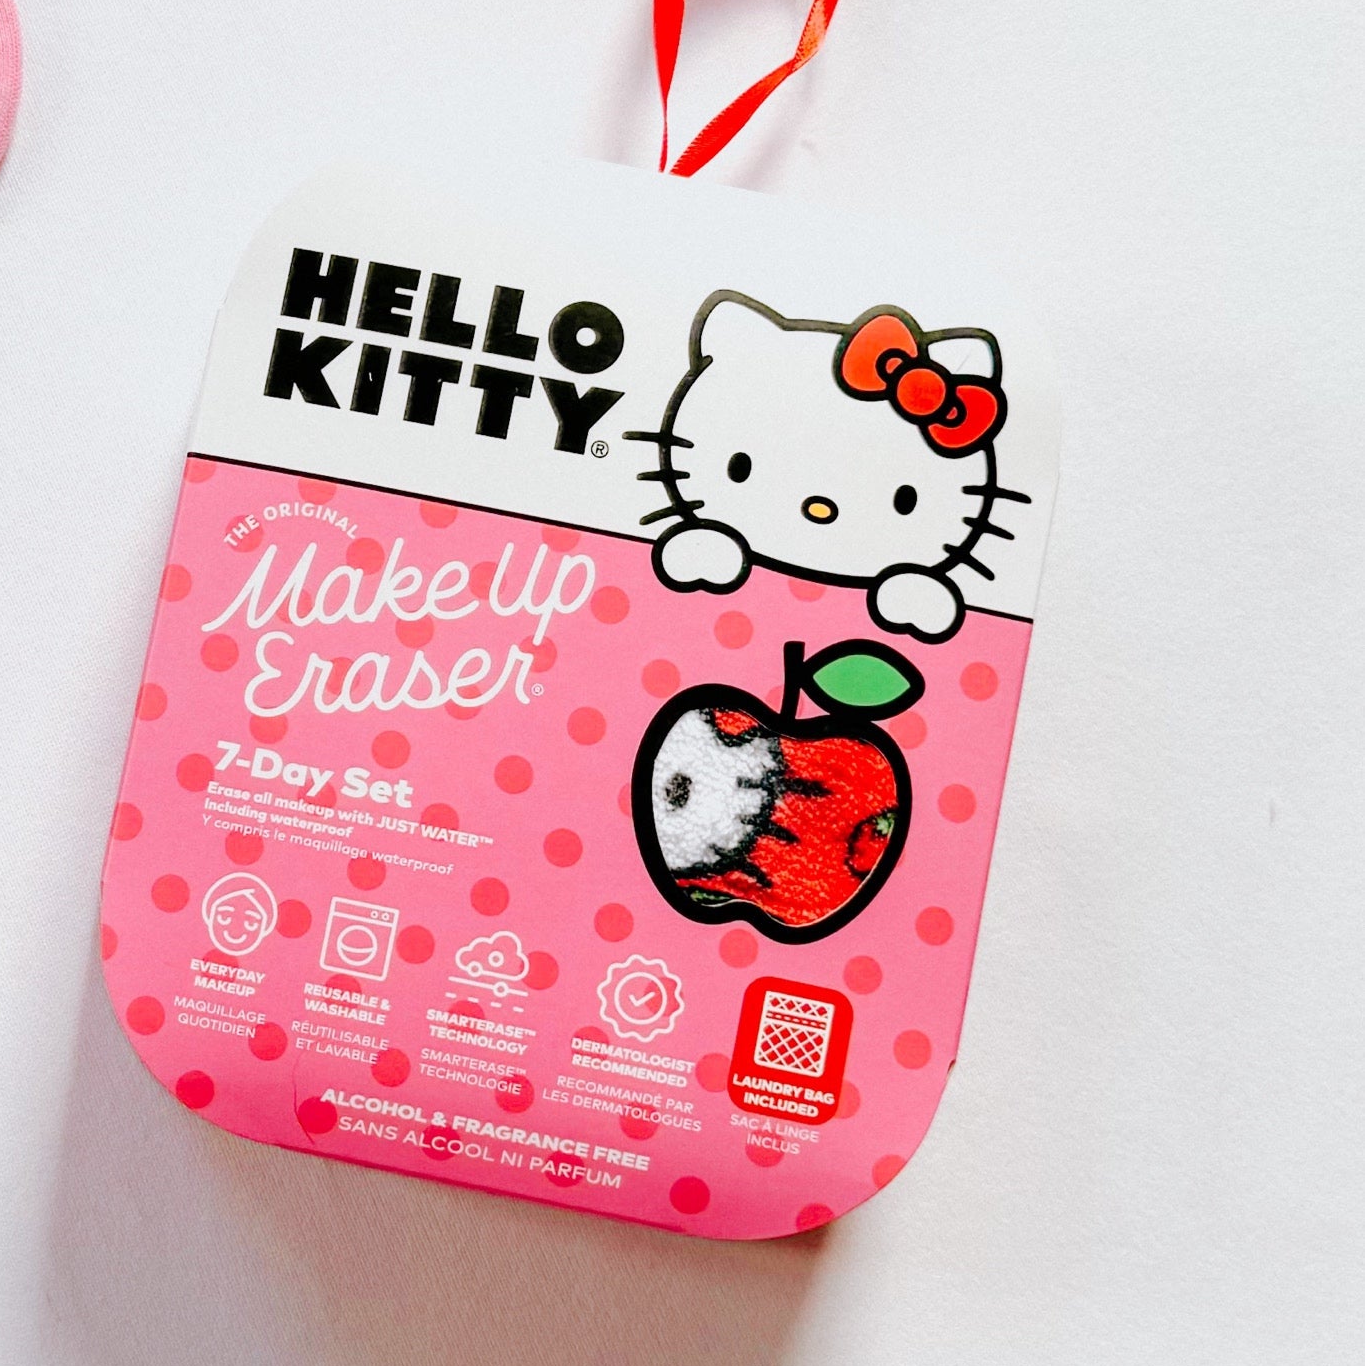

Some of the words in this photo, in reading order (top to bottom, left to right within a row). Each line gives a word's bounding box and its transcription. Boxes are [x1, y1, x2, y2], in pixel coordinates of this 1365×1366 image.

[280, 247, 625, 375] HELLO
[223, 514, 260, 547] THE
[263, 502, 359, 540] ORIGINAL
[213, 740, 335, 798] 7-Day
[339, 766, 415, 809] Set
[204, 797, 268, 823] Including
[269, 813, 355, 838] waterproof
[207, 780, 251, 802] Erase
[253, 791, 273, 806] all
[274, 796, 335, 820] makeup
[337, 809, 374, 826] with
[376, 815, 420, 835] JUST
[202, 813, 212, 827] Y
[213, 818, 271, 840] compris
[273, 829, 287, 842] le
[289, 834, 368, 859] maquillage
[371, 849, 455, 875] waterproof
[190, 958, 267, 984] EVERYDAY
[194, 975, 256, 998] MAKEUP
[173, 995, 267, 1025] MAQUILLAGE
[303, 982, 379, 1009] REUSABLE
[380, 998, 392, 1012] &
[304, 998, 387, 1026] WASHABLE
[177, 1013, 257, 1039] QUOTIDIEN
[291, 1019, 390, 1051] RÉUTILISABLE
[428, 1024, 529, 1056] TECHNOLOGY
[295, 1038, 312, 1051] ET
[315, 1042, 379, 1065] LAVABLE
[571, 1037, 696, 1074] DERMATOLOGIST
[419, 1062, 523, 1096] TECHNOLOGIE
[571, 1053, 688, 1088] RECOMMENDED
[557, 1075, 663, 1108] RECOMMANDÉ
[665, 1098, 694, 1114] PAR
[732, 1073, 804, 1098] LAUNDRY
[803, 1088, 835, 1105] BAG
[743, 1091, 819, 1118] INCLUDED
[542, 1088, 570, 1104] LES
[572, 1094, 703, 1133] DERMATOLOGUES
[320, 1088, 427, 1123] ALCOHOL
[431, 1111, 447, 1128] &
[451, 1115, 590, 1159] FRAGRANCE
[592, 1146, 651, 1172] FREE
[730, 1113, 760, 1130] SAC
[761, 1118, 773, 1134] À
[775, 1122, 820, 1143] LINGE
[746, 1133, 801, 1155] INCLUS
[338, 1115, 398, 1141] SANS
[402, 1129, 495, 1163] ALCOOL
[500, 1151, 523, 1169] NI
[529, 1155, 623, 1190] PARFUM
